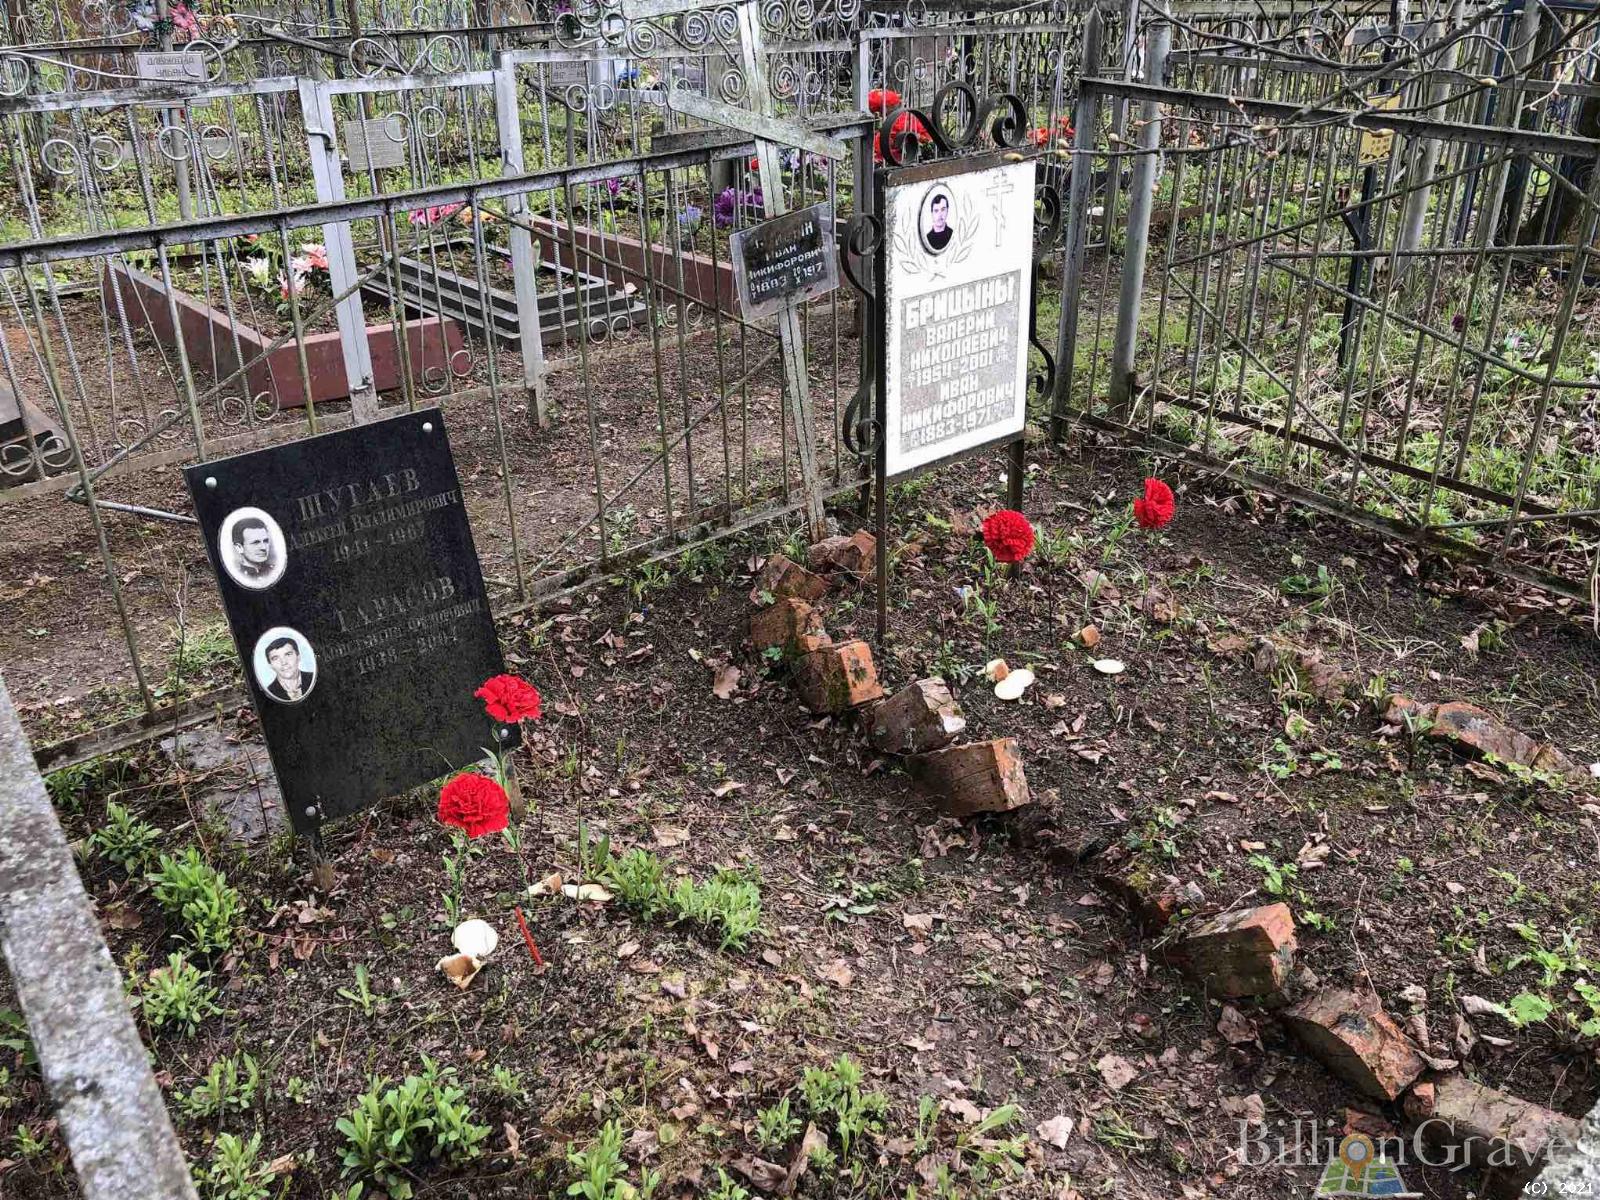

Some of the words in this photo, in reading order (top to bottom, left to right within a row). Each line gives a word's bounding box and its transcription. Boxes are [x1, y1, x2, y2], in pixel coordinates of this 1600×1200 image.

[905, 275, 1015, 330] БРИЦЫНЫ
[910, 326, 1009, 374] НИКОЛАЕВИЧ
[902, 381, 1015, 434] НИКИФОРОВИЧ
[940, 373, 979, 402] ИВАН
[297, 467, 420, 522] ШУГАЕВ
